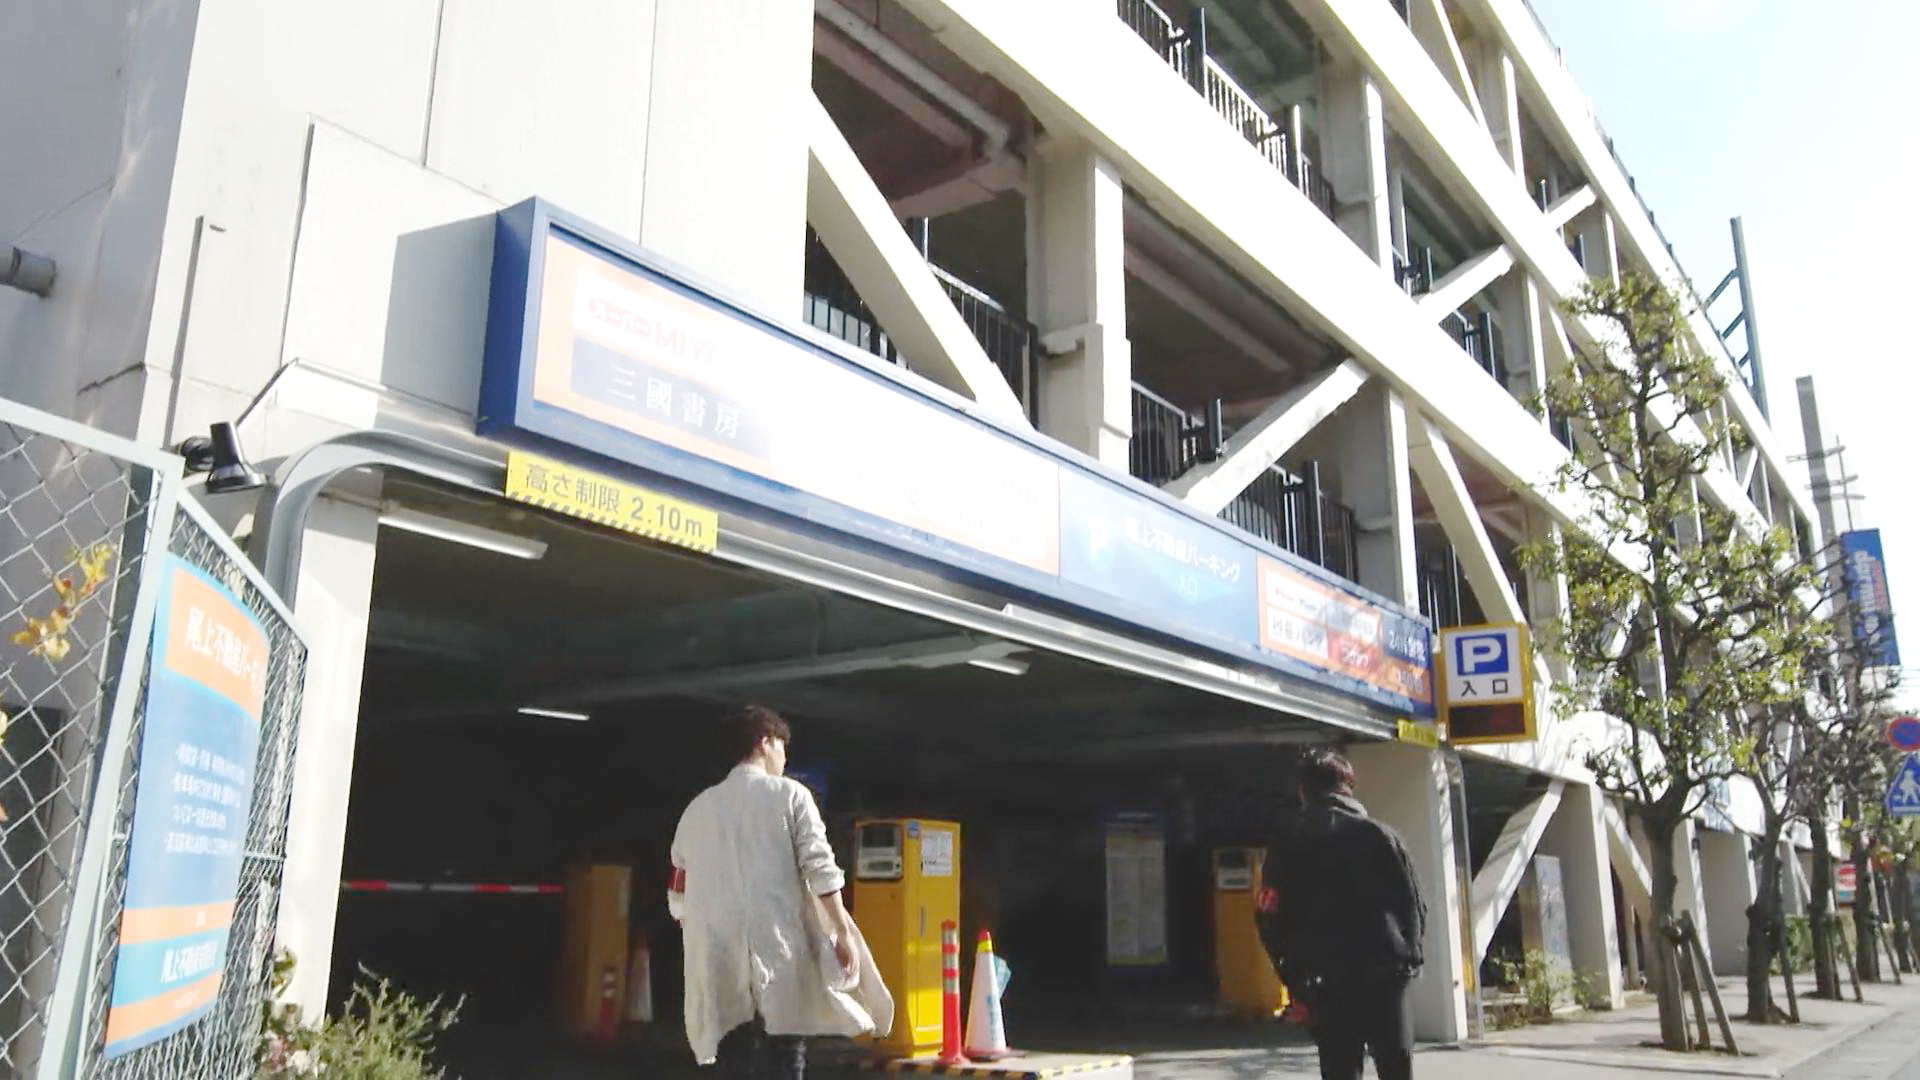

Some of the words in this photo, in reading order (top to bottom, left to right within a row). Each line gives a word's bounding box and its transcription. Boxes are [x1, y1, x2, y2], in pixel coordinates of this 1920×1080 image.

[608, 365, 740, 440] 三國書房
[526, 464, 620, 514] 高さ制限
[630, 496, 703, 538] 2.10m
[1461, 637, 1502, 673] P
[1461, 679, 1508, 697] 入口
